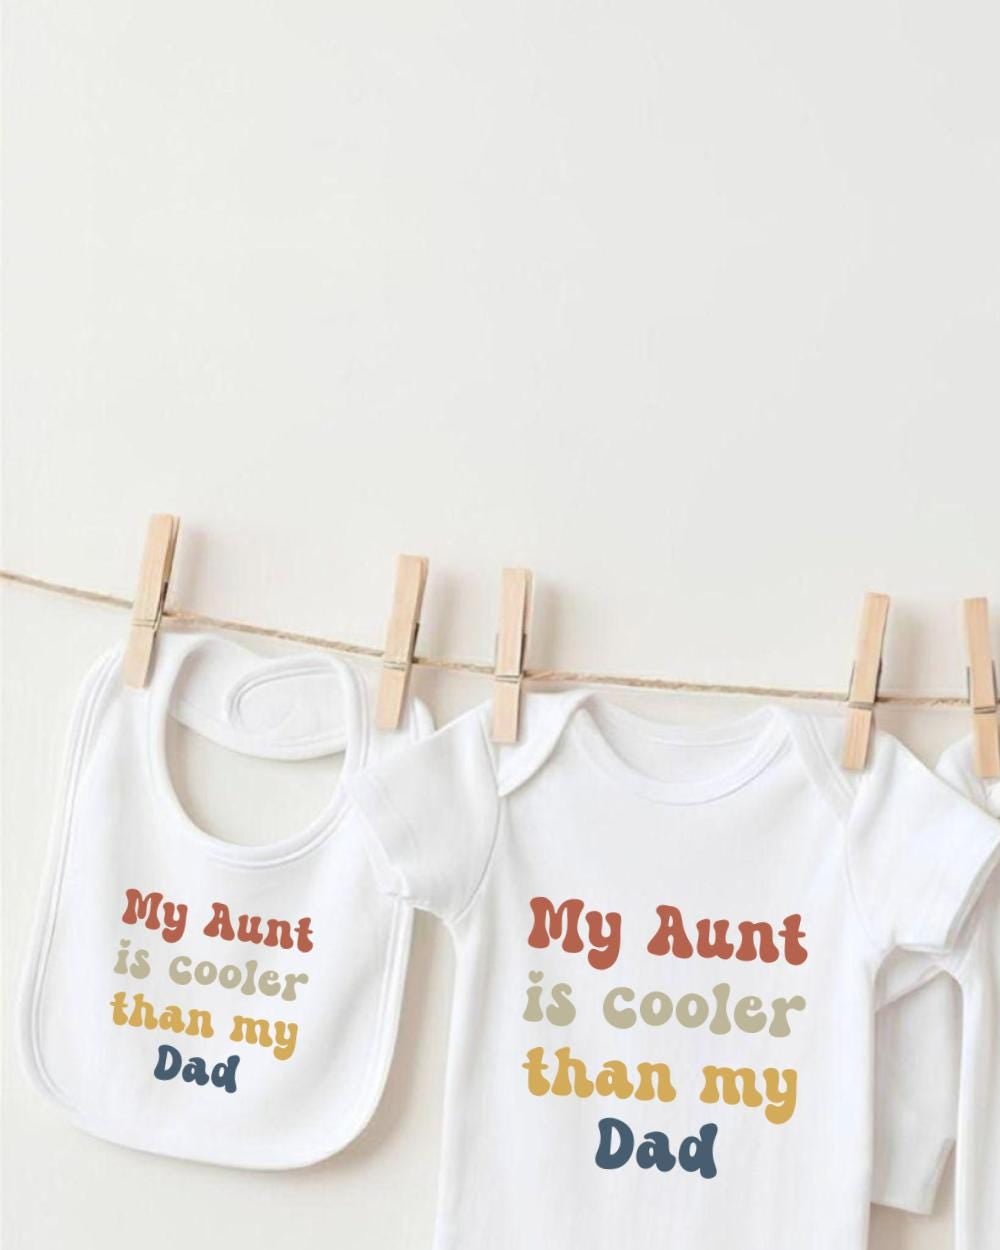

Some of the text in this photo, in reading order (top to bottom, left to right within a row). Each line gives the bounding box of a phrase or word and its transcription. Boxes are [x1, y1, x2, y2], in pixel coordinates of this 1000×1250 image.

[122, 888, 314, 953] My Aunt
[527, 896, 808, 970] My Aunt
[113, 938, 309, 1002] is cooler
[110, 991, 299, 1061] than my
[522, 970, 806, 1038] is cooler
[153, 1044, 240, 1094] Dad
[522, 1046, 798, 1125] than my
[595, 1117, 718, 1179] Dad
